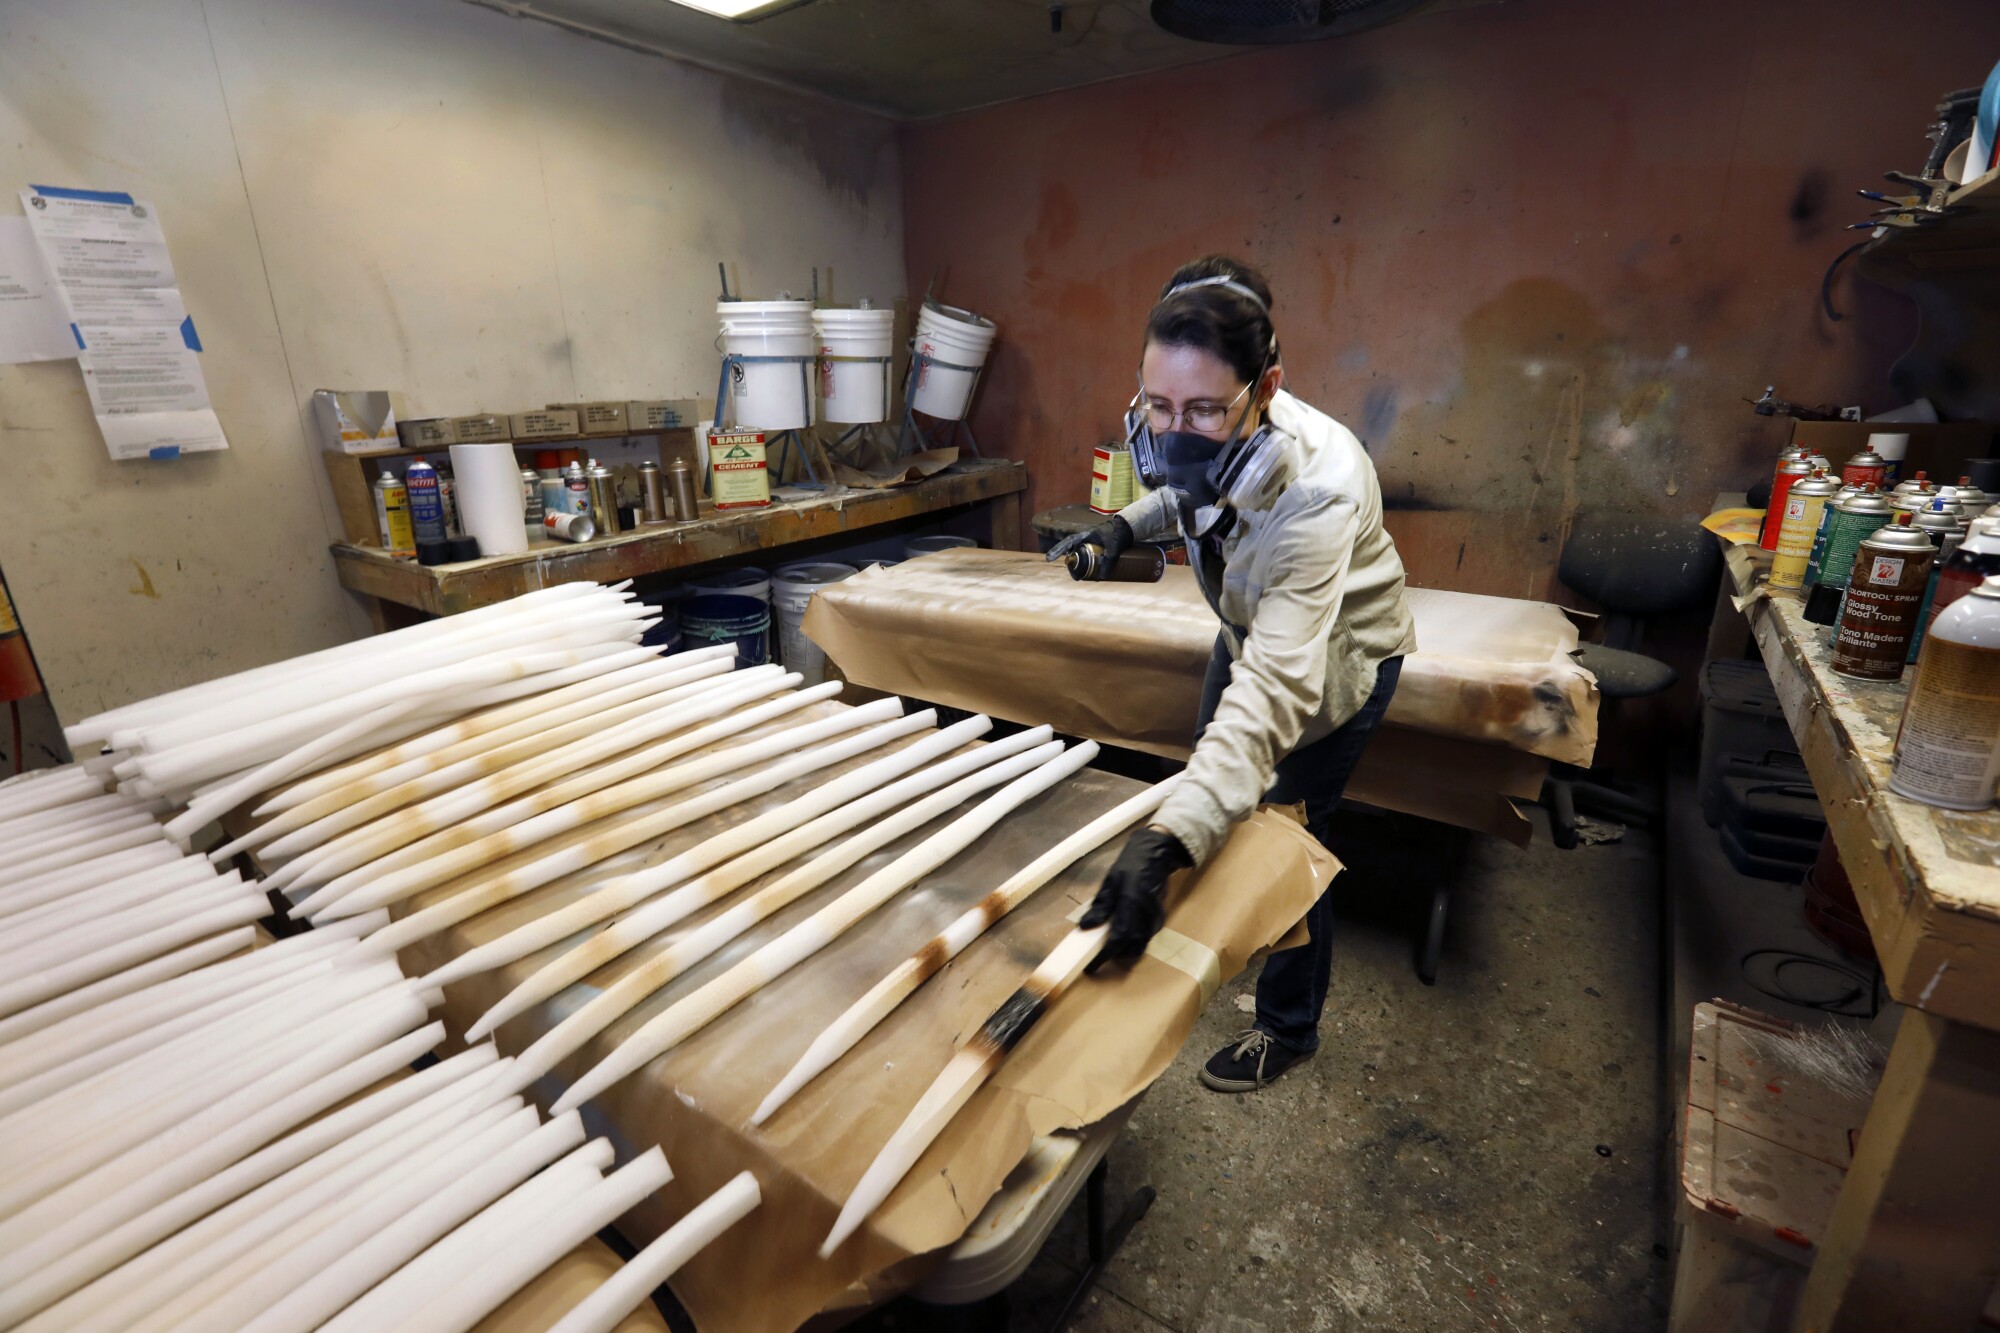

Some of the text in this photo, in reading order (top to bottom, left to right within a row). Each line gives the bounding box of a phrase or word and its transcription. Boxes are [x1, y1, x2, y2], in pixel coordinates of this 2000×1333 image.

[716, 435, 757, 444] BARGE
[1847, 599, 1879, 613] Glossy
[1846, 606, 1902, 622] Wood Tone
[1839, 634, 1877, 649] Brillante
[1840, 625, 1904, 643] Tono Madera
